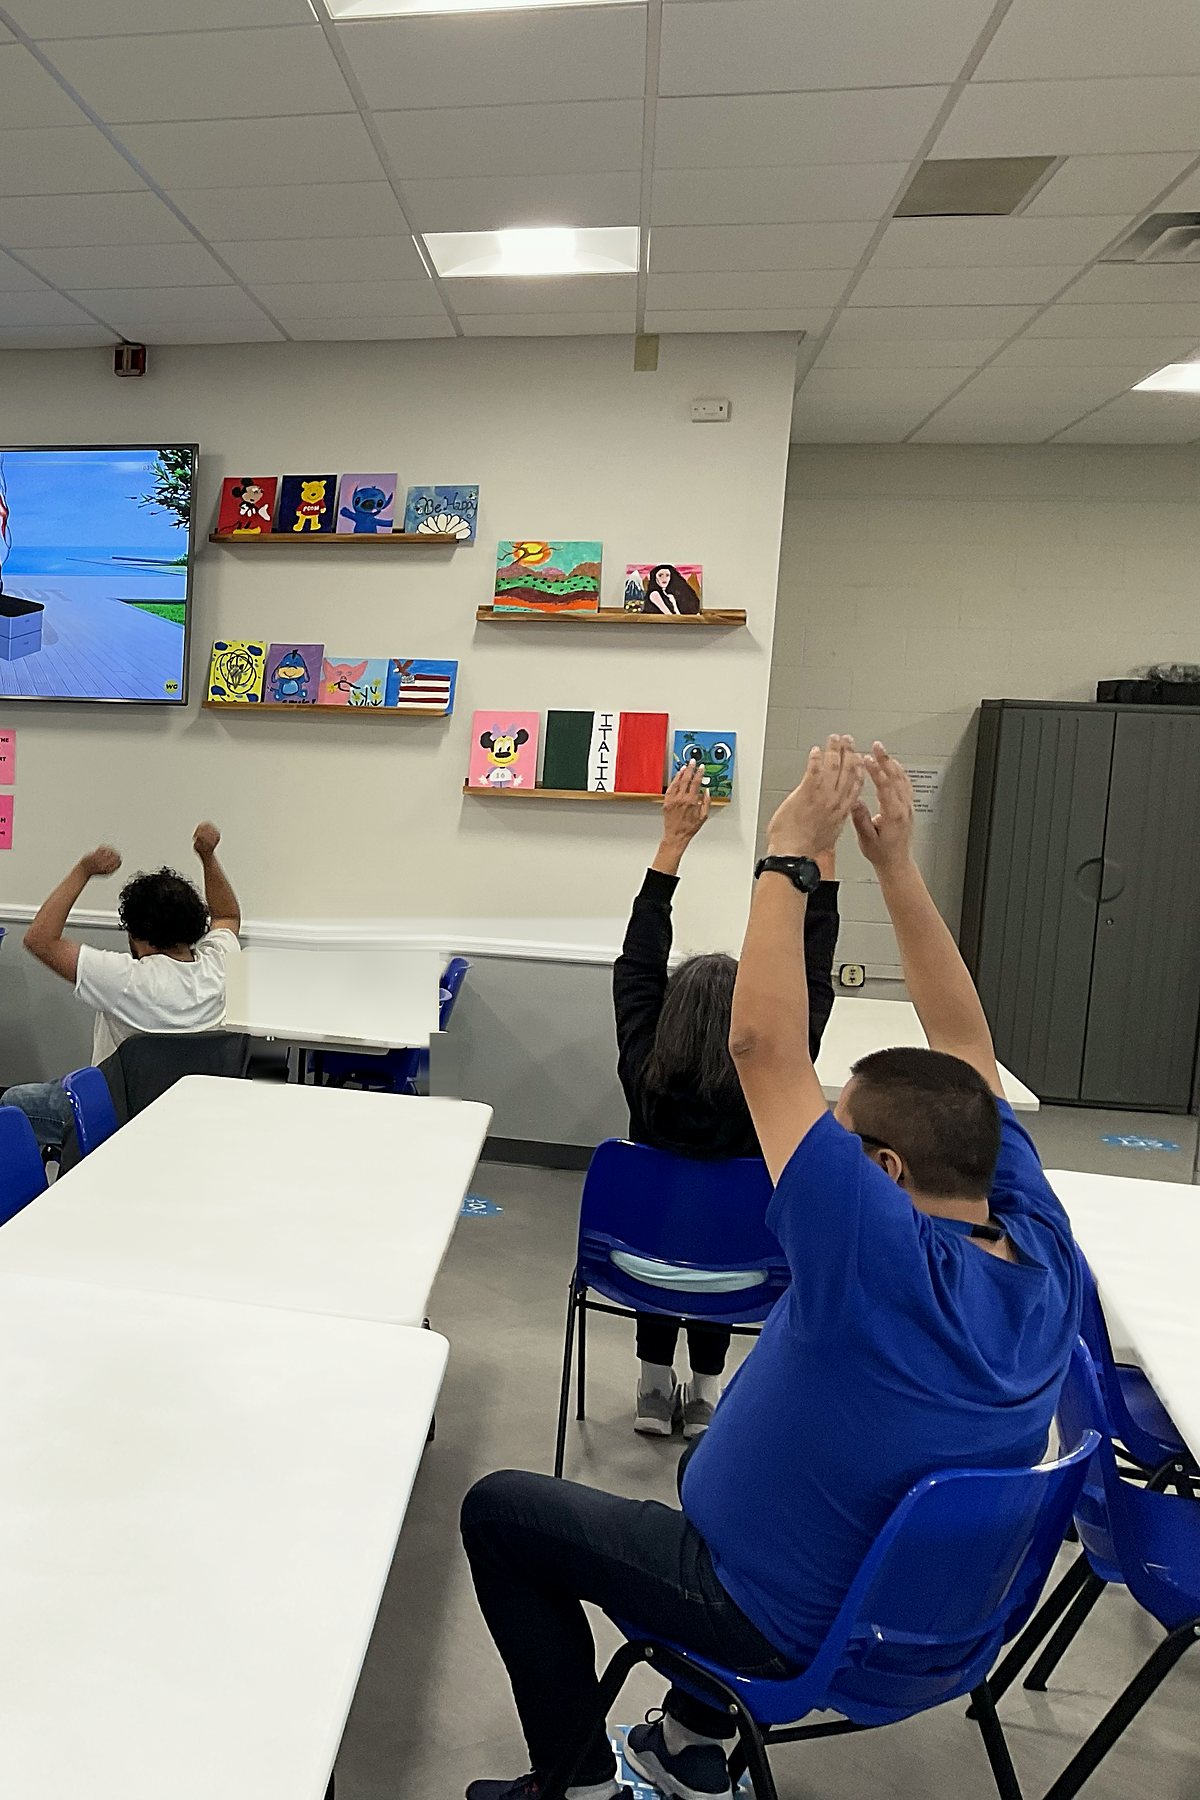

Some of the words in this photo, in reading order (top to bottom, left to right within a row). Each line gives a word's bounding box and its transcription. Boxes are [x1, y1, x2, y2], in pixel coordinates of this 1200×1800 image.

[418, 497, 442, 515] Be
[442, 491, 477, 519] Happy
[595, 714, 613, 792] ITALIA
